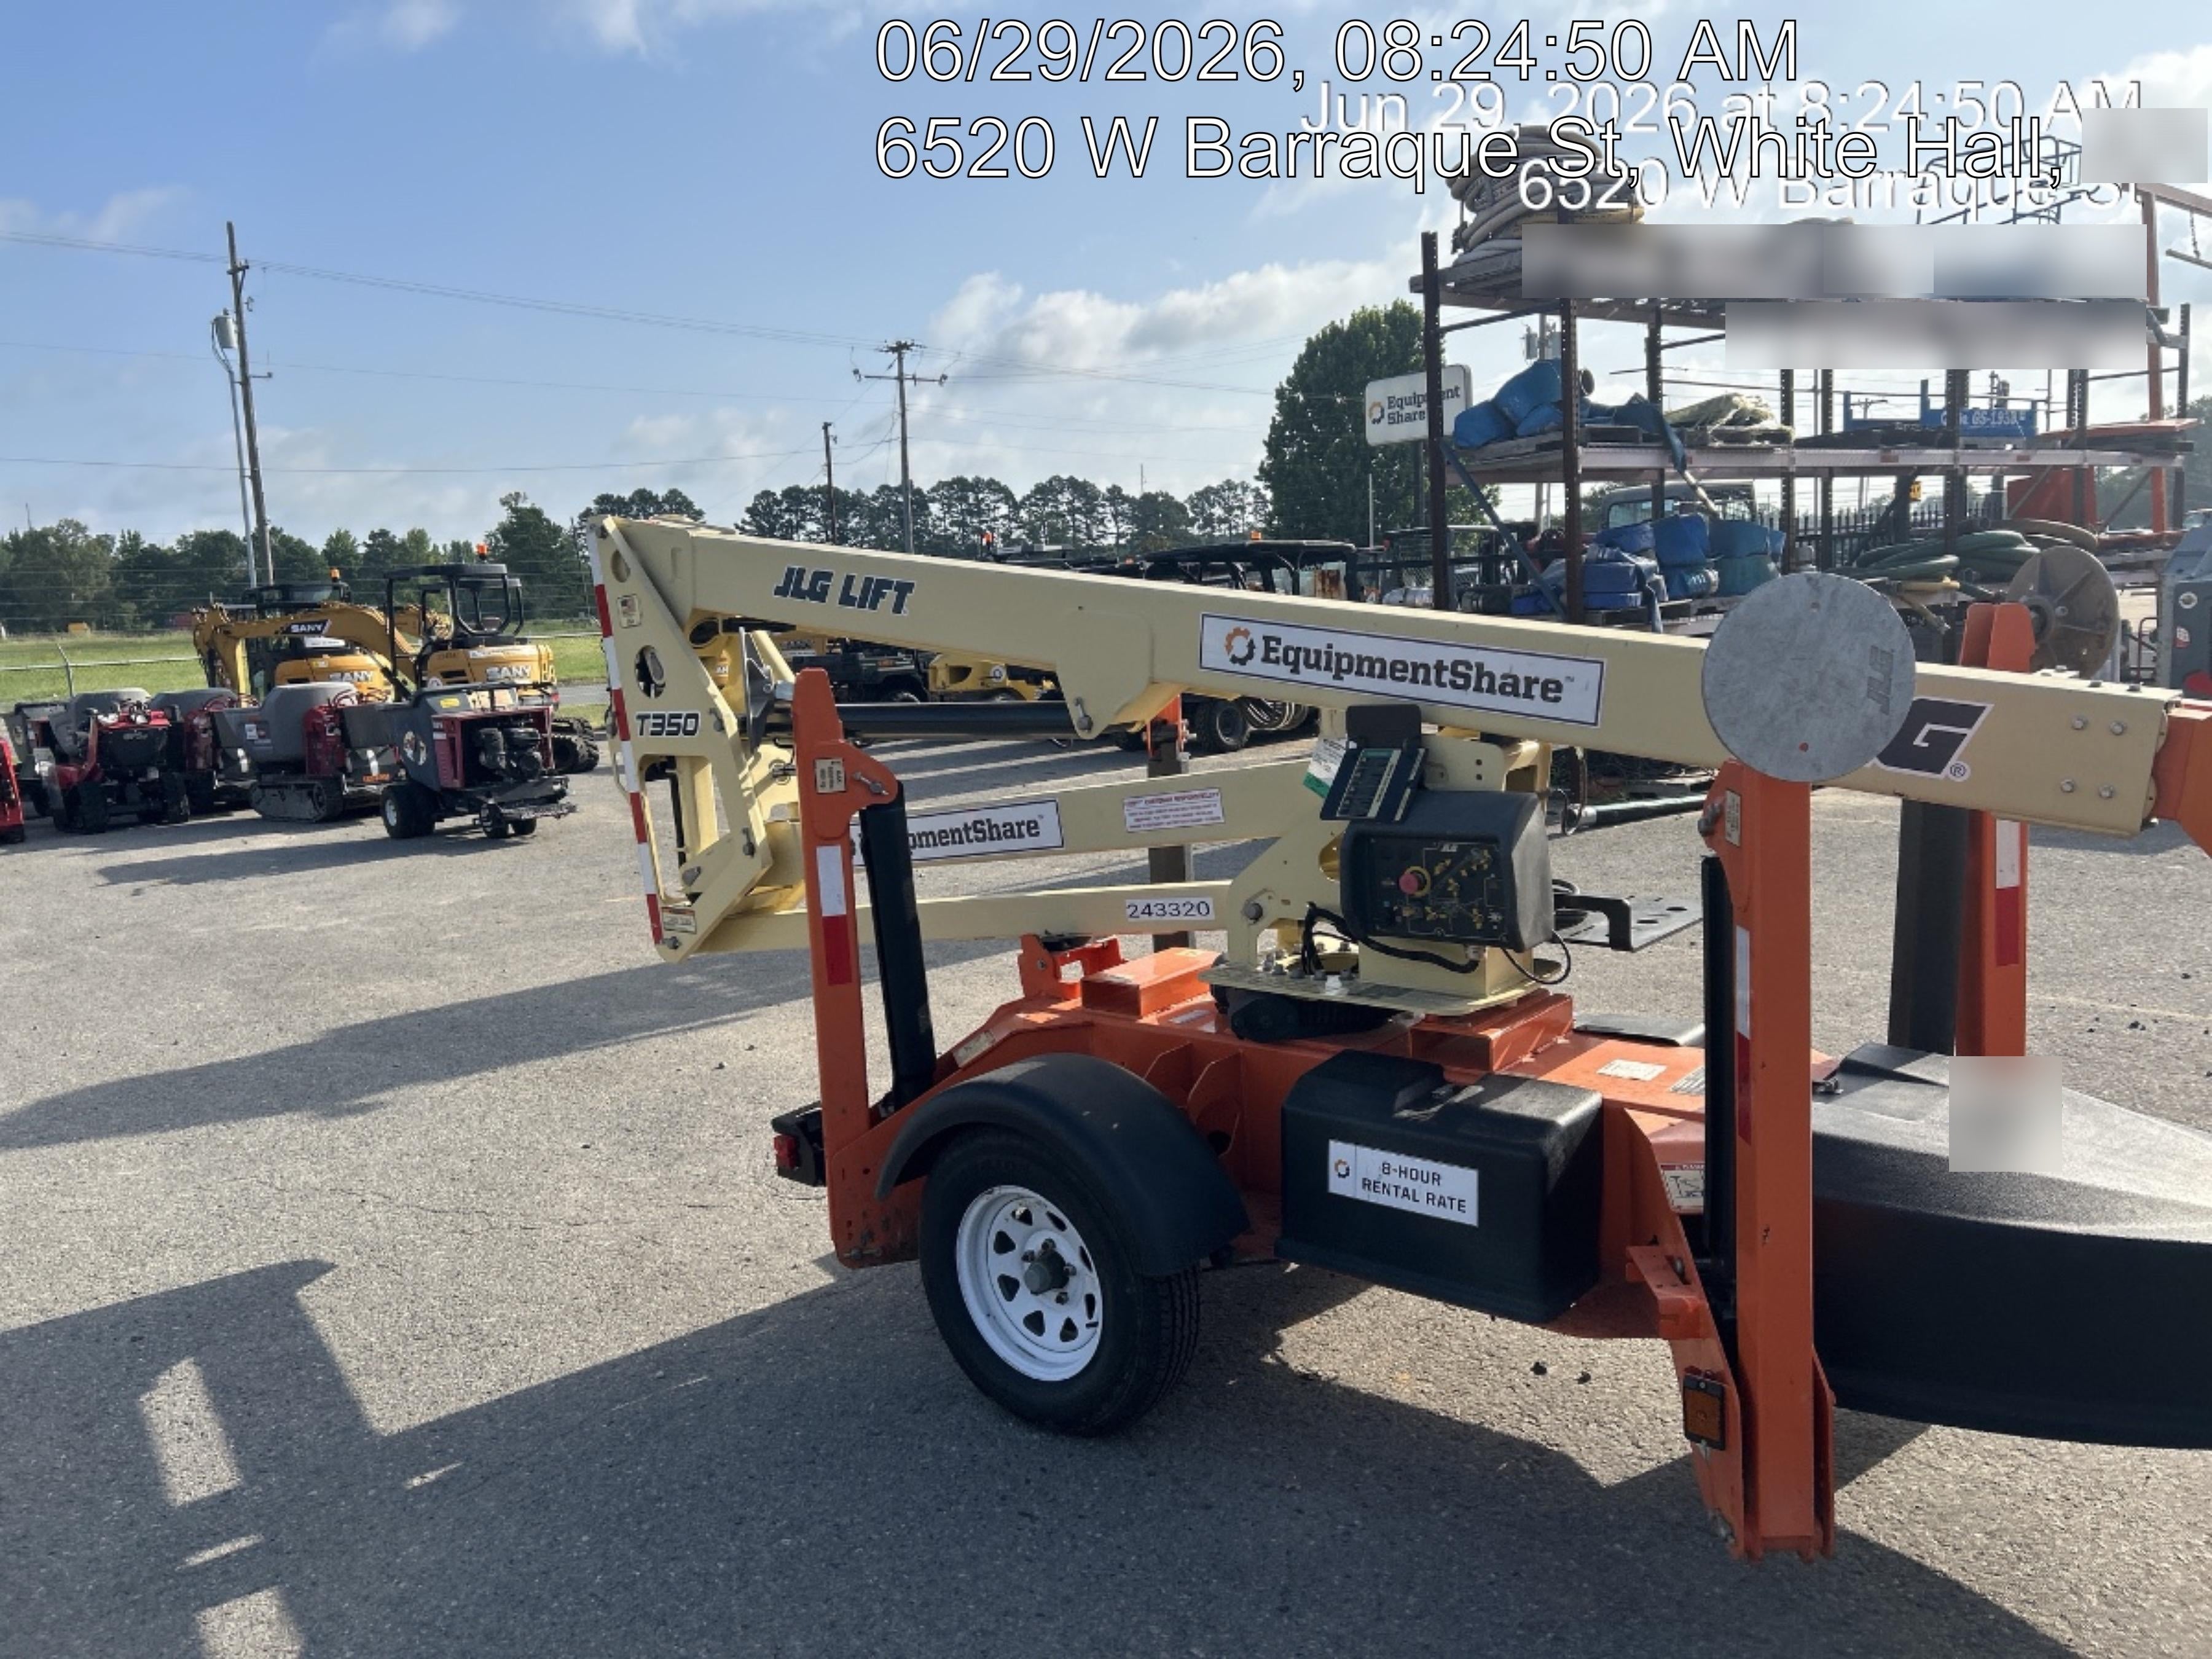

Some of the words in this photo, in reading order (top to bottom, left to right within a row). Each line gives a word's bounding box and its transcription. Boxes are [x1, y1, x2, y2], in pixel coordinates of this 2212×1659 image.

[1387, 385, 1461, 410] Equipent
[1387, 410, 1426, 425] Share
[774, 567, 834, 603] JLG
[838, 573, 915, 614] LIFT
[290, 623, 323, 633] SANY
[329, 670, 374, 682] SANY
[486, 665, 531, 680] SANY
[1261, 635, 1564, 704] EquipmentShare
[635, 711, 700, 737] T350
[908, 818, 1040, 856] pmentShare
[1127, 900, 1210, 919] 243320
[1381, 1162, 1441, 1186] 8-HOUR
[1362, 1177, 1420, 1202] RENTAL
[1426, 1192, 1467, 1214] RATE
